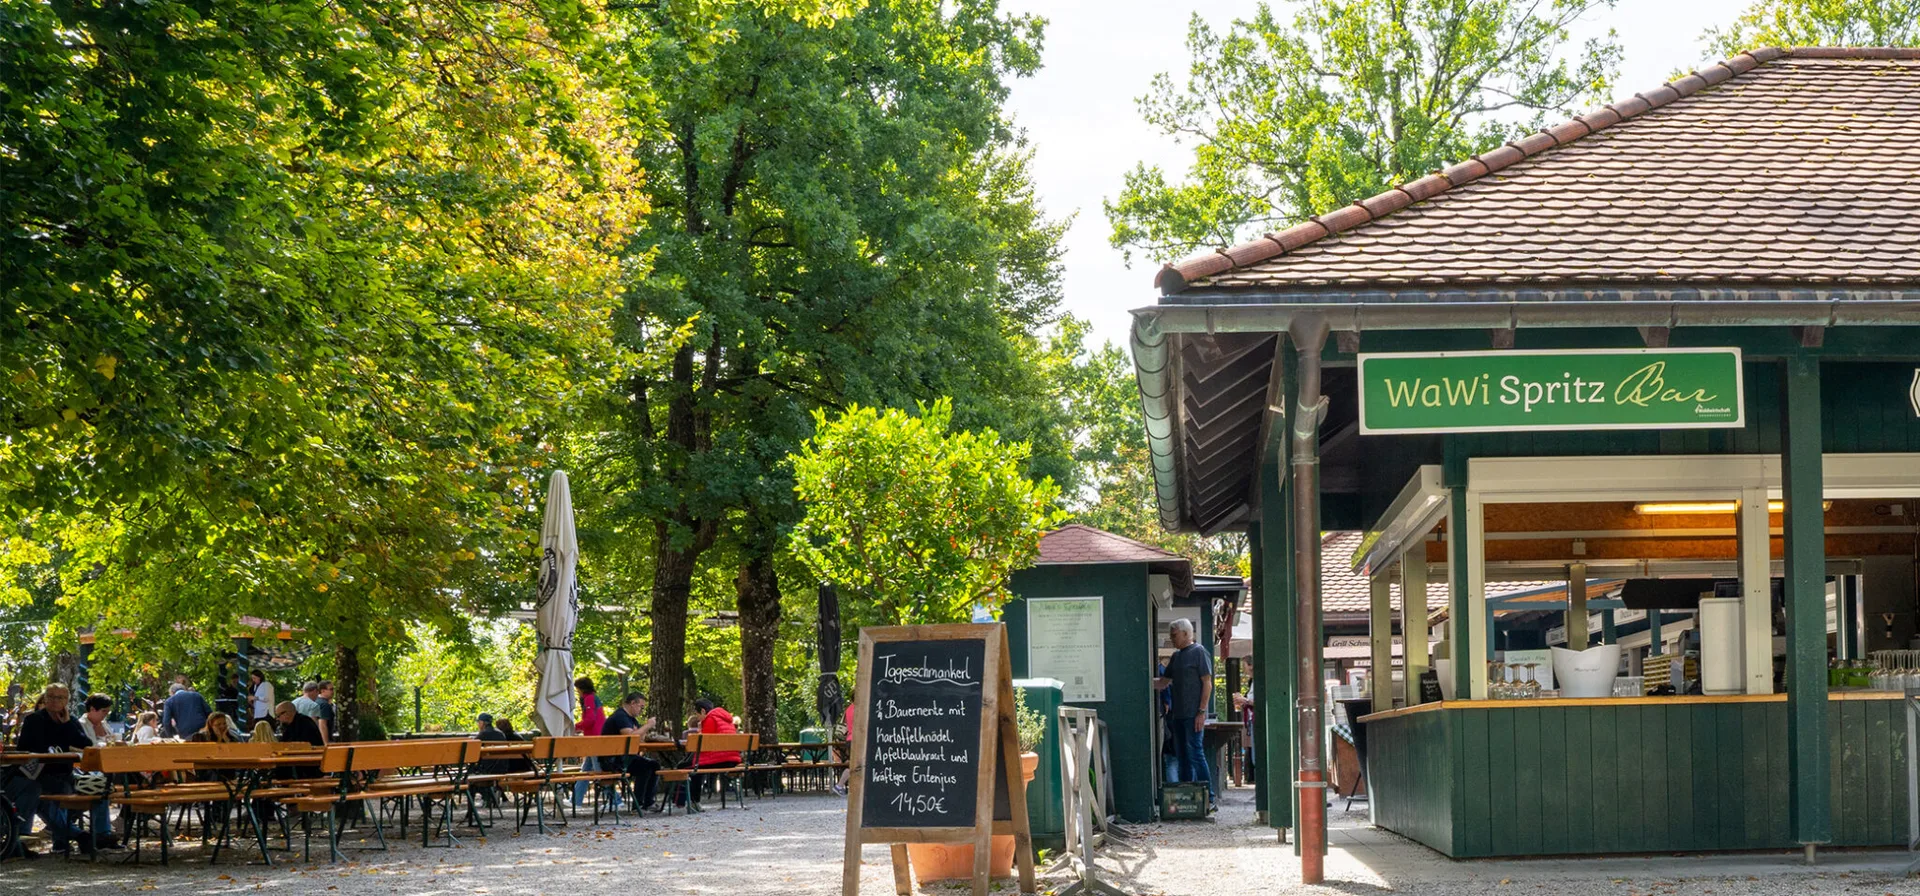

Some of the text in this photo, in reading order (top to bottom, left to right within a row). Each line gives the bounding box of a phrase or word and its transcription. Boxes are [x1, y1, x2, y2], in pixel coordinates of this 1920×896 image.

[1384, 361, 1717, 412] WaWi Spritz Bar
[878, 653, 971, 684] Tagesschmankerl
[884, 699, 944, 719] Bauernente
[948, 700, 966, 716] mit
[875, 745, 969, 765] Apfelblaukraut und
[912, 765, 957, 792] Entenjus
[890, 792, 948, 815] 14,50€
